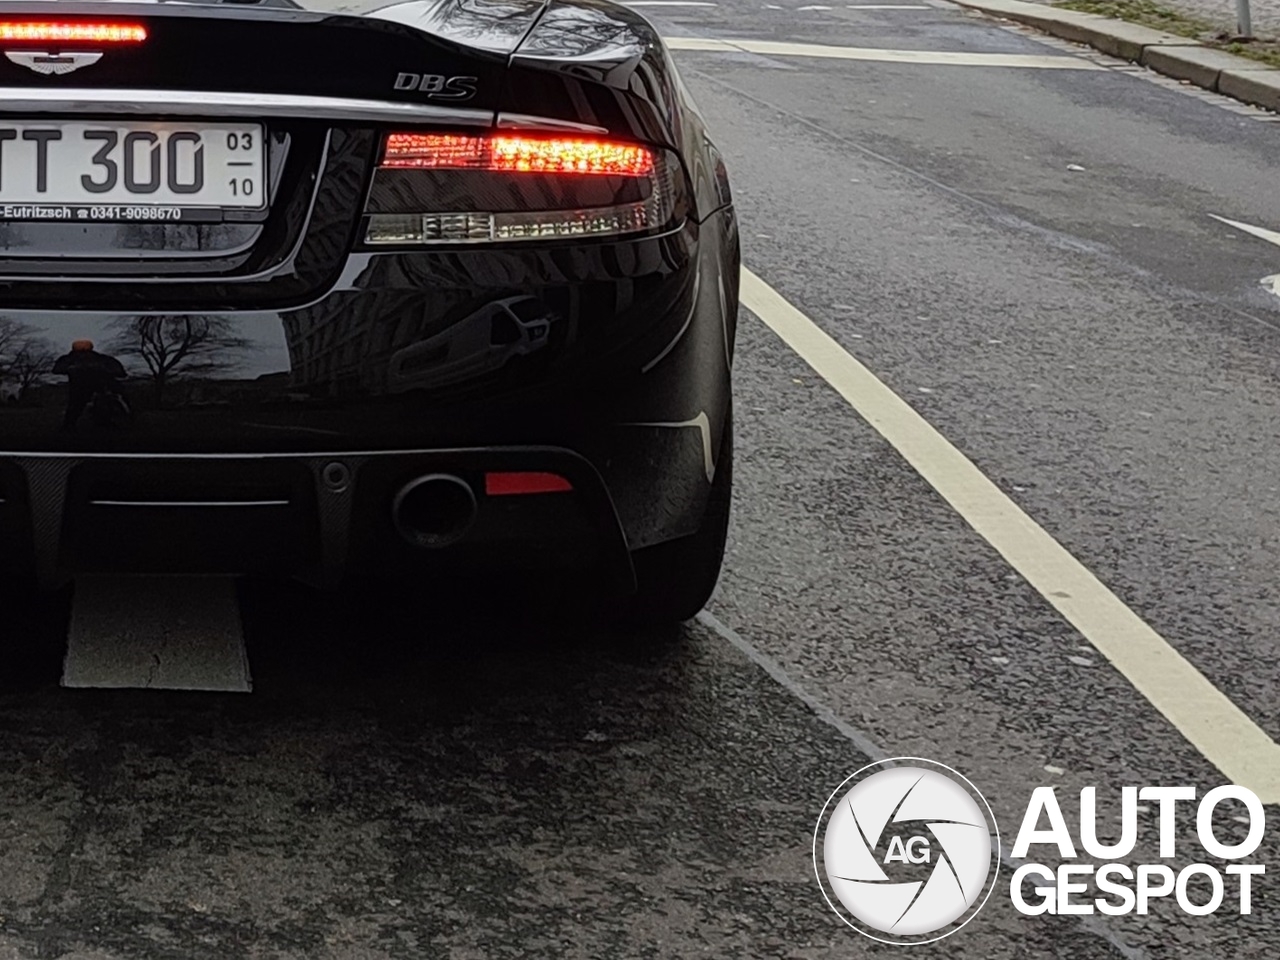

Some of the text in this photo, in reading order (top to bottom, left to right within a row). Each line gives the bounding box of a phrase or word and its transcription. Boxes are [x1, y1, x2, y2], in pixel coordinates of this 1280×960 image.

[393, 72, 478, 101] DBS
[227, 132, 253, 151] 03
[81, 130, 204, 194] 300
[229, 178, 253, 196] 10
[90, 207, 182, 220] 0341-9098670
